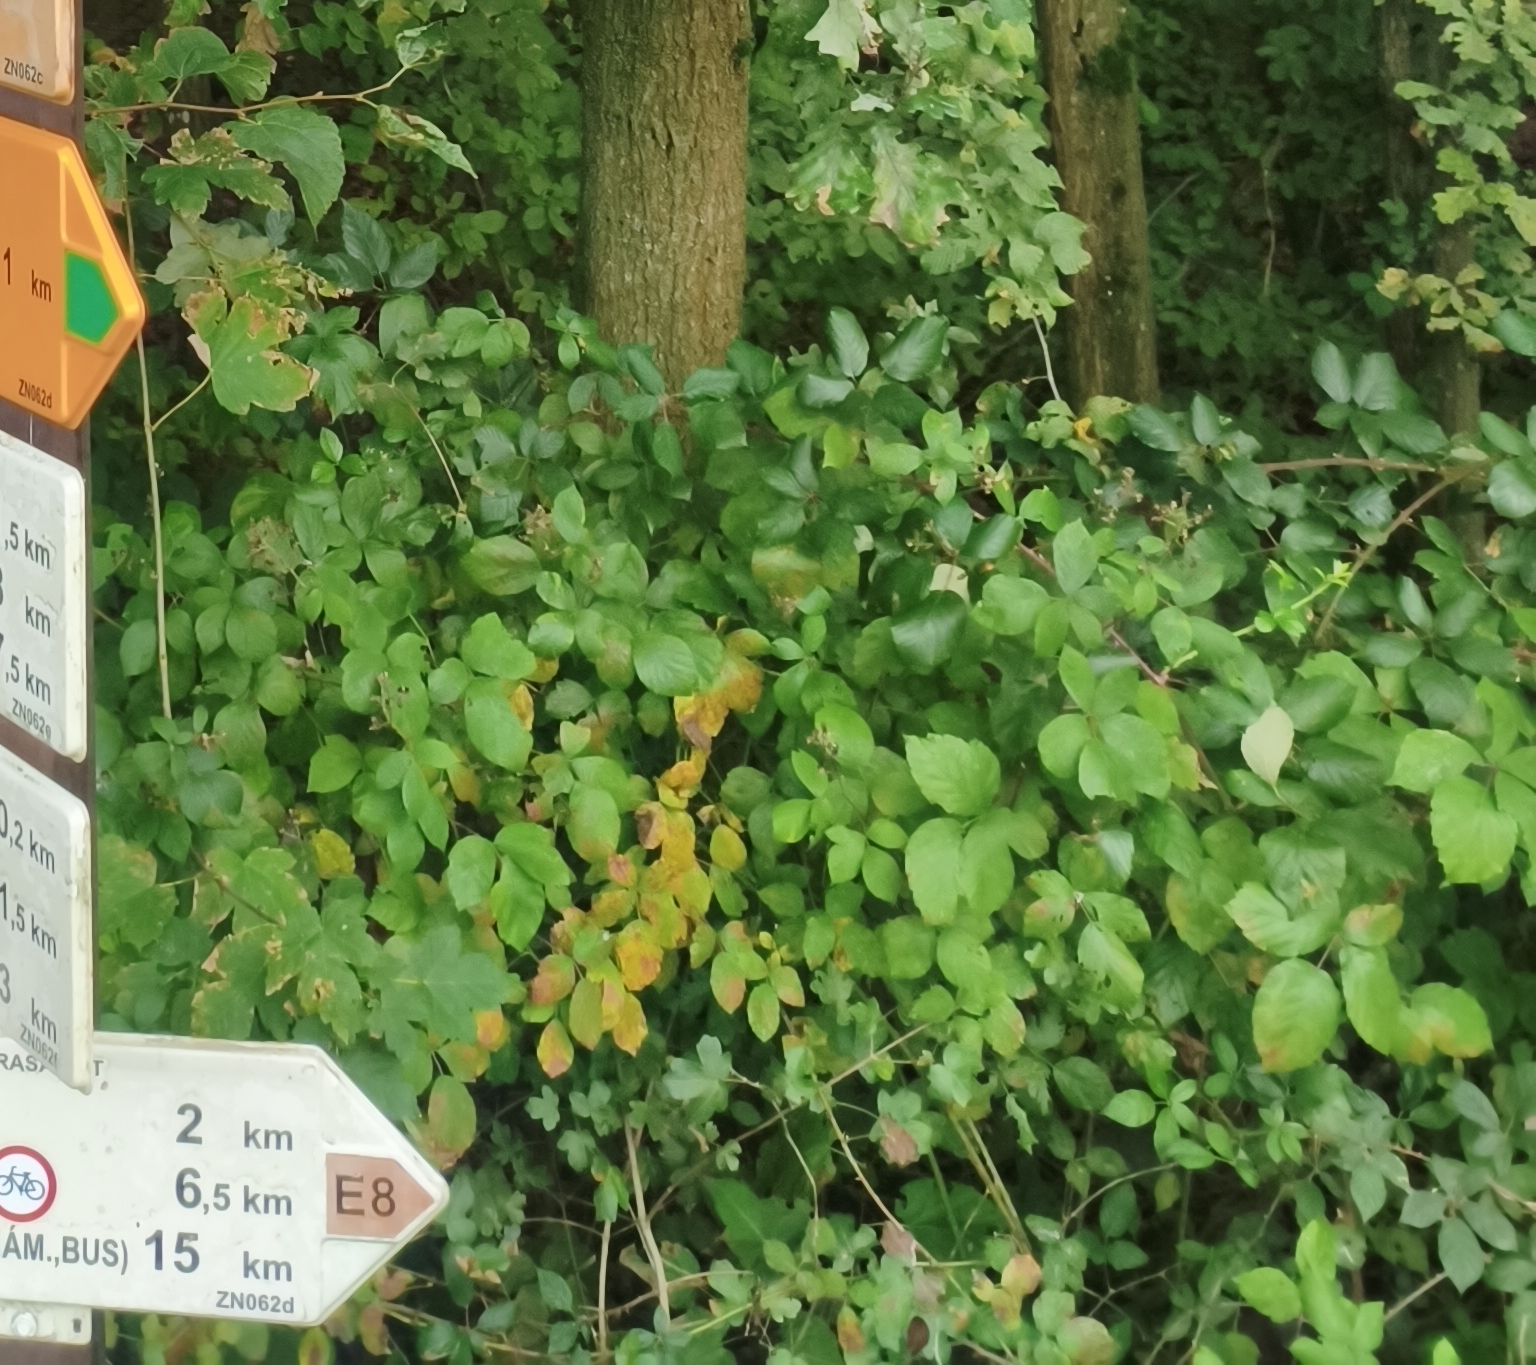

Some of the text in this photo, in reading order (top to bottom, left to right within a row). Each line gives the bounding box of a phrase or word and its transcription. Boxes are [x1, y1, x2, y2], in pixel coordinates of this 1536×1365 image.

[4, 58, 43, 85] ZN062c
[4, 246, 11, 286] 1
[32, 270, 51, 302] km
[19, 379, 52, 408] ZN062d
[25, 528, 50, 569] km
[25, 595, 50, 636] km
[25, 664, 50, 706] km
[29, 829, 56, 875] km
[30, 913, 57, 959] km
[0, 963, 11, 1004] 3
[31, 998, 57, 1044] km
[176, 1103, 203, 1145] 2
[243, 1122, 293, 1151] km
[175, 1168, 231, 1213] 6,5
[243, 1187, 293, 1216] km
[335, 1174, 396, 1217] E8
[145, 1229, 200, 1274] 15
[243, 1252, 293, 1282] km
[216, 1289, 295, 1314] ZN062d
